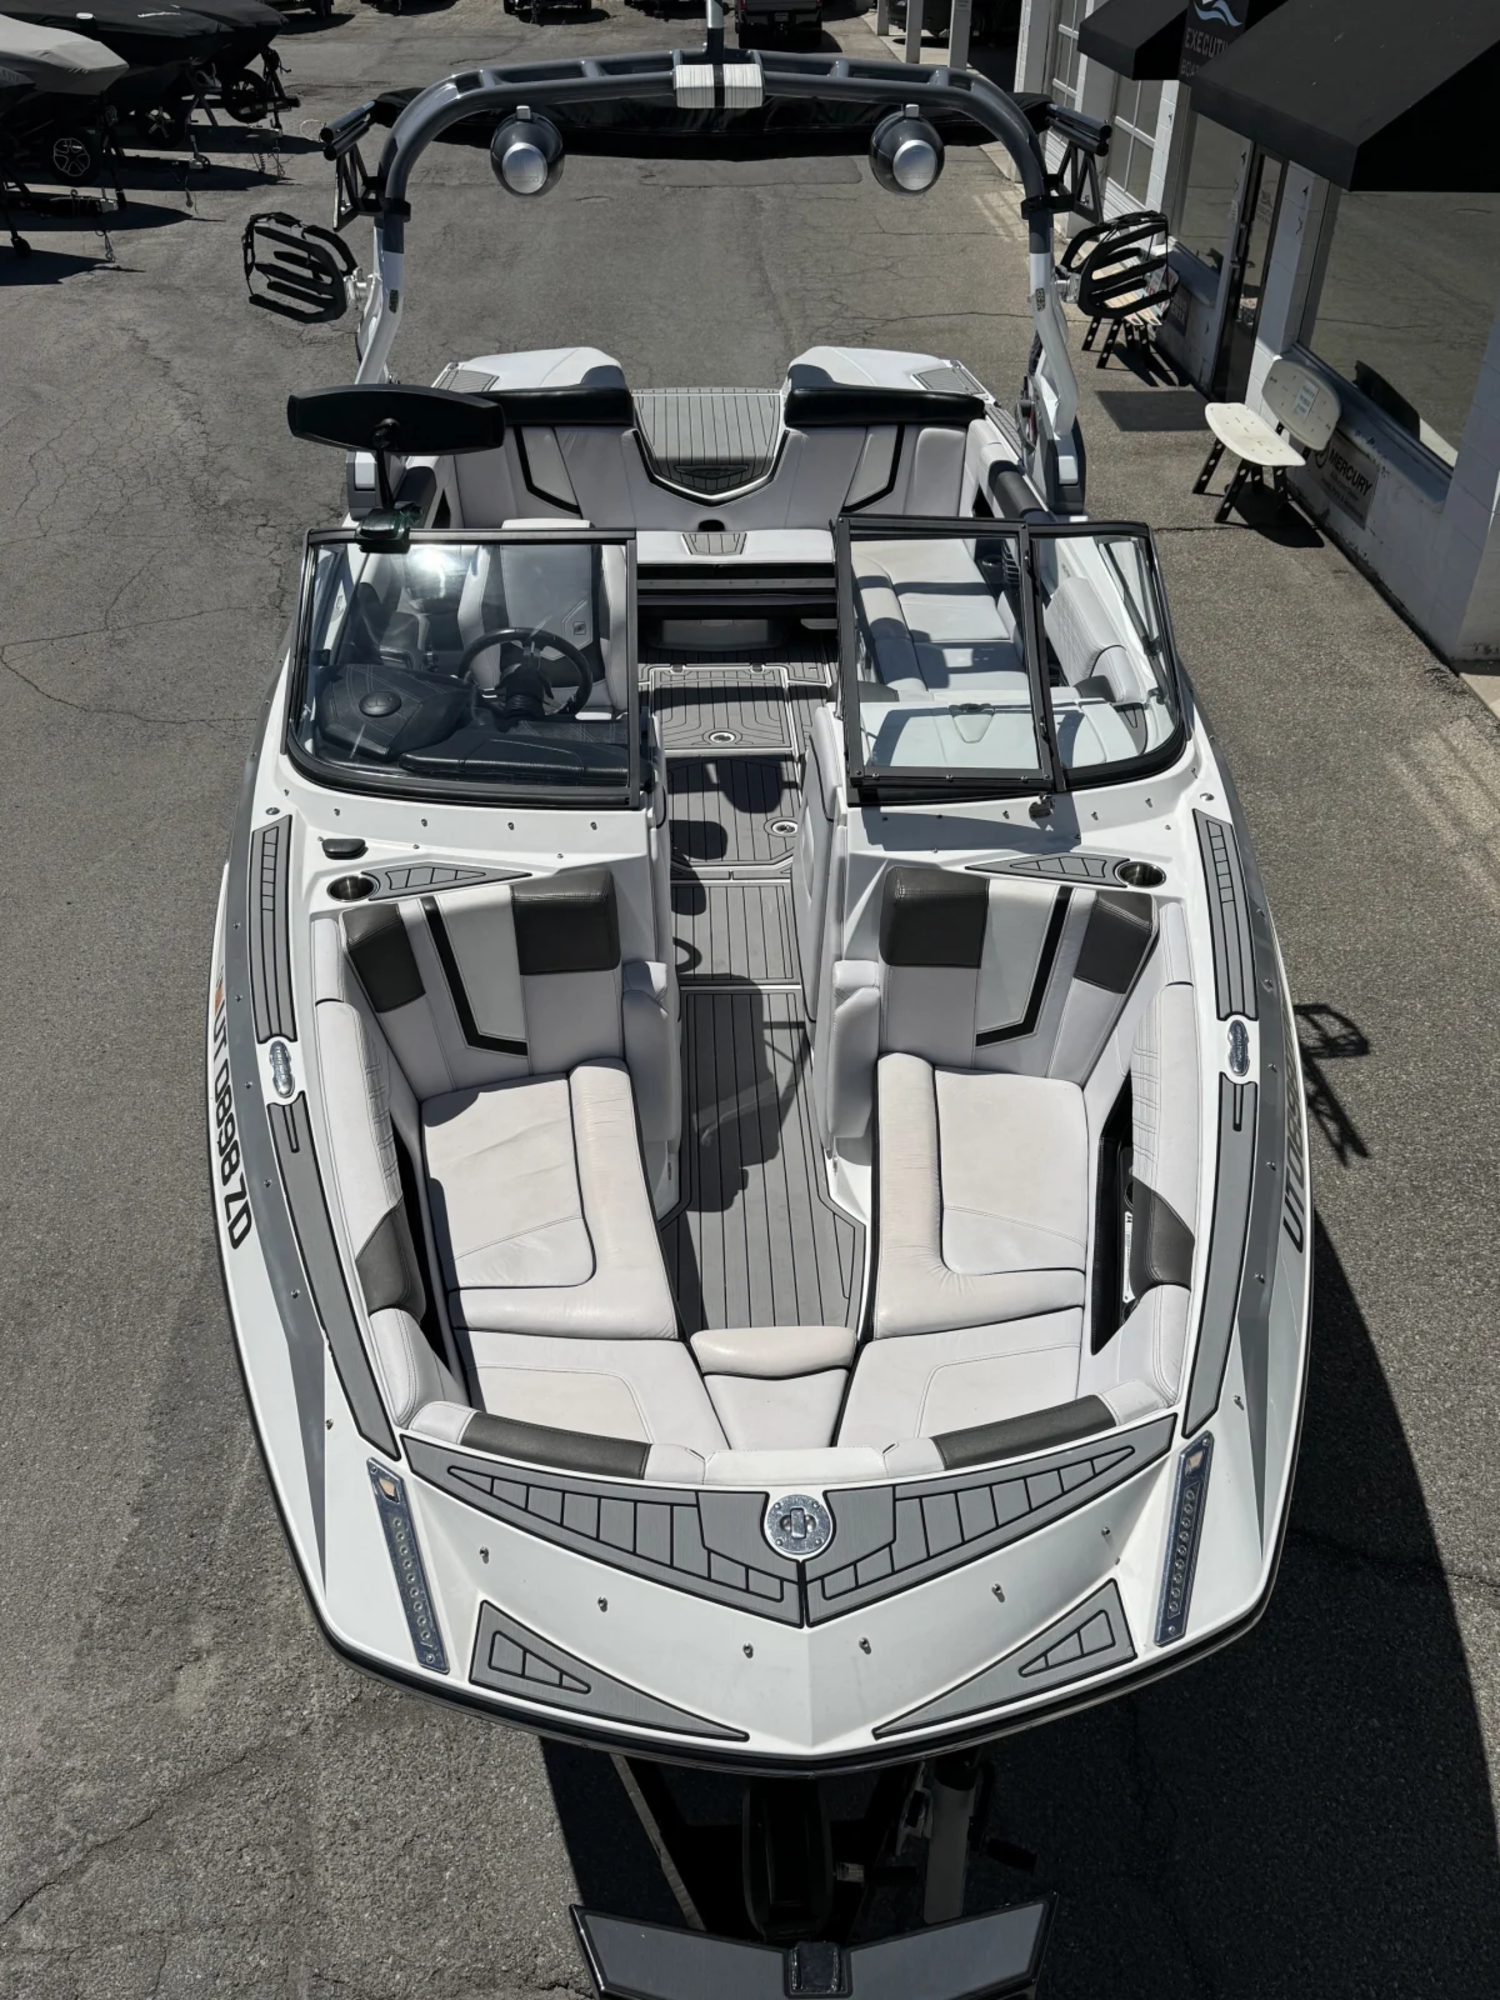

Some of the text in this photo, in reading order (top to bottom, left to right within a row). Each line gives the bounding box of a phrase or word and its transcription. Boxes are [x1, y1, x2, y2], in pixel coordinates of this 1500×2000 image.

[1329, 447, 1373, 496] MERCURY
[214, 1058, 241, 1187] 0898
[224, 1171, 252, 1250] ZD
[1283, 1166, 1305, 1254] UT
